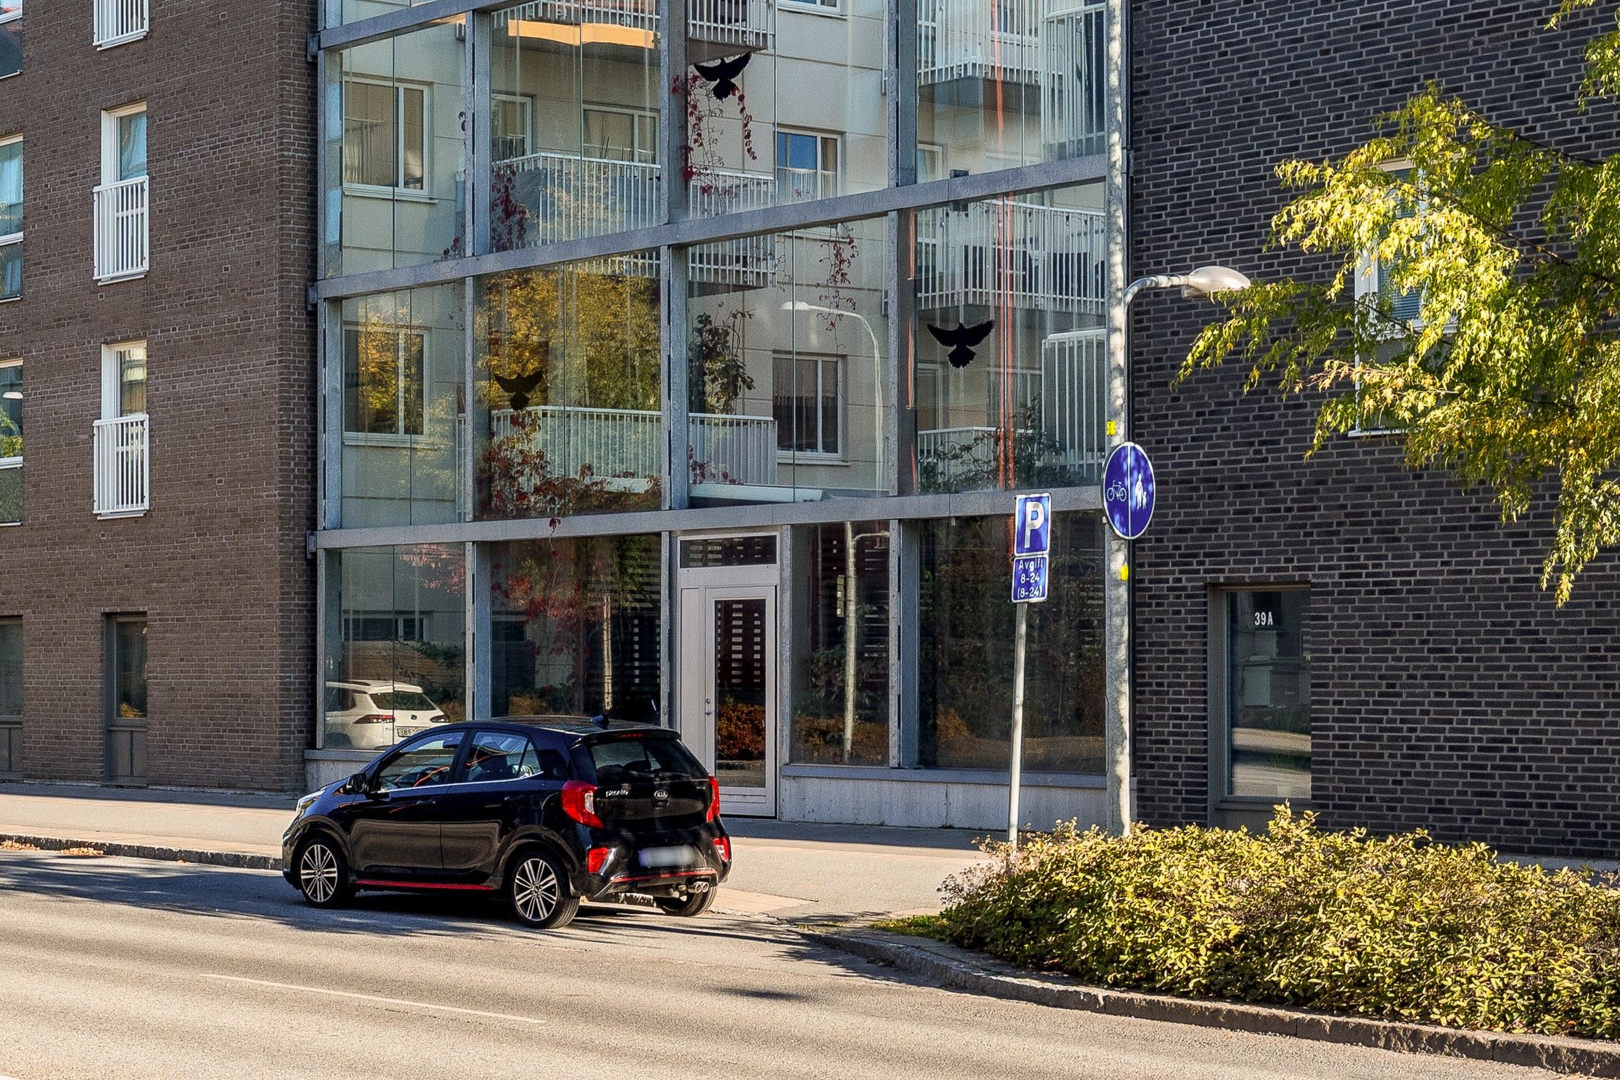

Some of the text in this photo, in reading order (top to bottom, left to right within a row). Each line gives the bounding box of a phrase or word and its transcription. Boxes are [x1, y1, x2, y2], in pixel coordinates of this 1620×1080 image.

[1024, 501, 1045, 549] P
[1018, 558, 1044, 571] Avgift
[1021, 573, 1040, 584] 8-24
[1017, 585, 1042, 599] (8-24)
[1254, 611, 1274, 626] 39A
